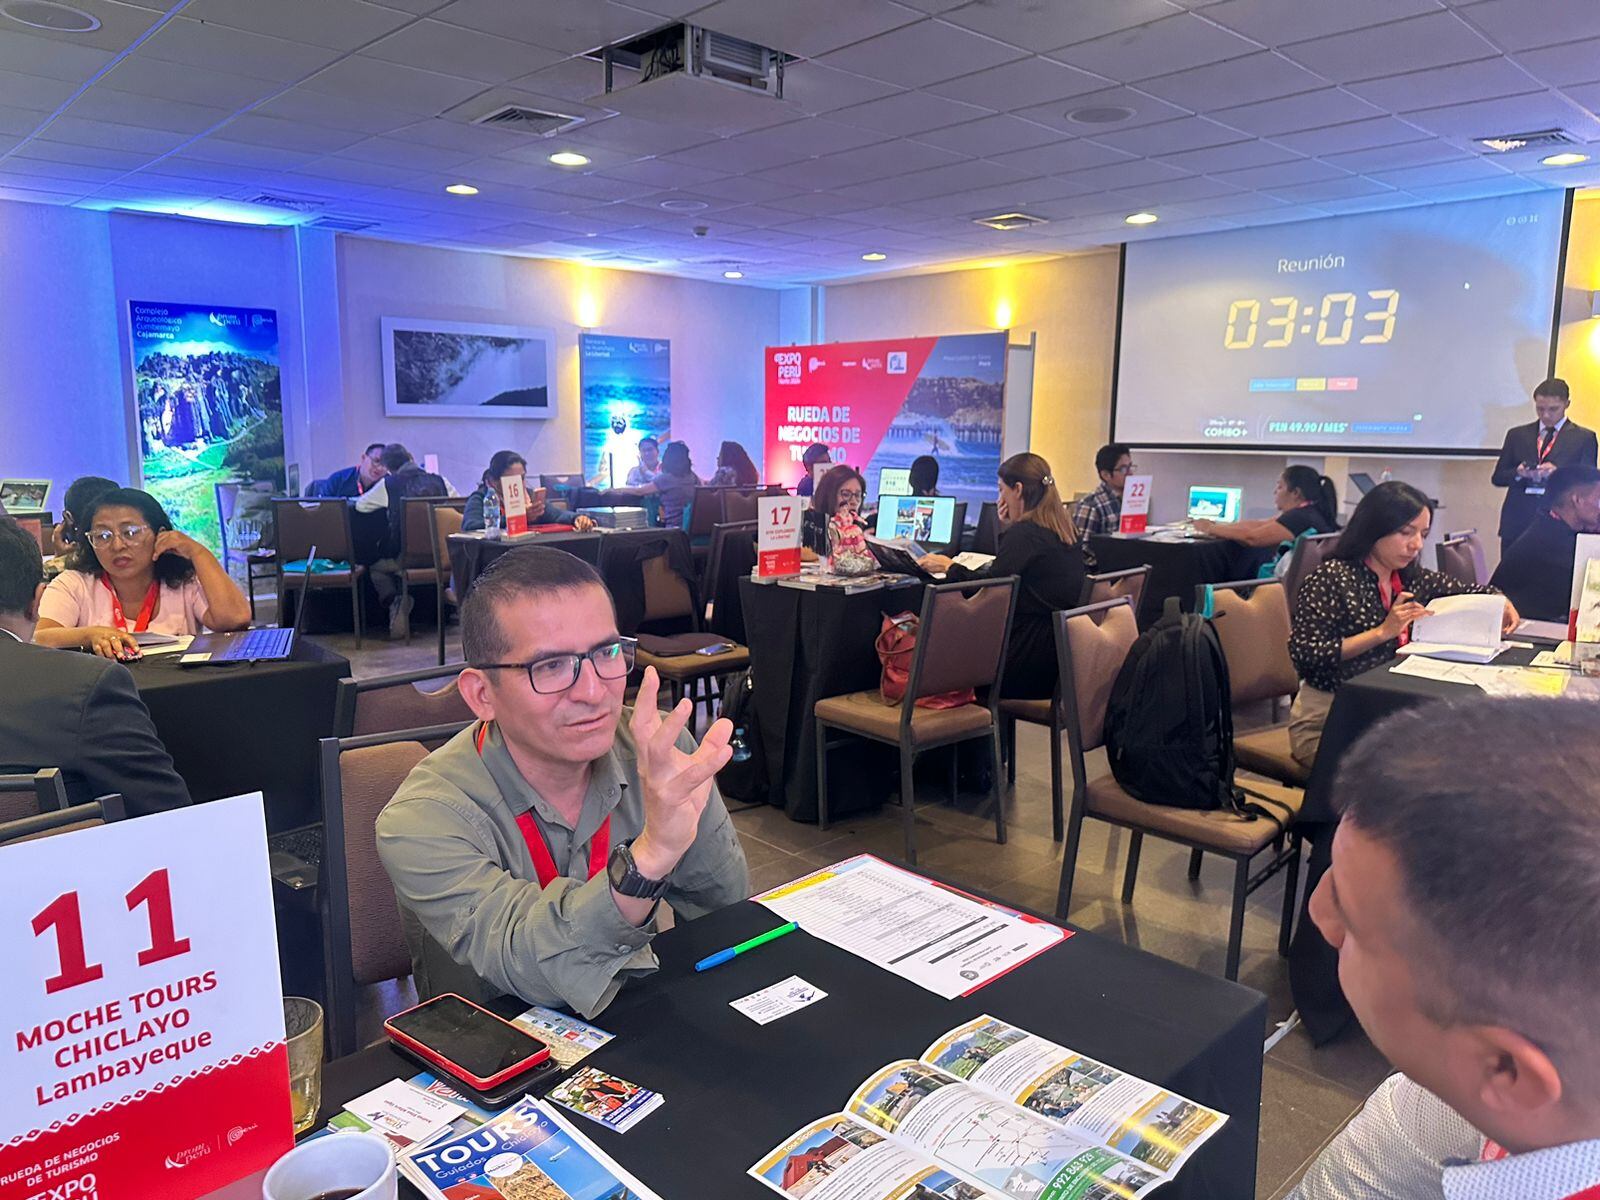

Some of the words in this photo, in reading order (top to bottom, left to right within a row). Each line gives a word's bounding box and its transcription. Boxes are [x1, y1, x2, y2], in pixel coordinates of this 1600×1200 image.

[1277, 254, 1345, 273] Reunión
[135, 307, 168, 316] Complejo
[1224, 289, 1400, 349] 03:03
[137, 331, 175, 340] Cajamarca
[787, 406, 830, 423] RUEDA
[832, 406, 851, 423] DE
[778, 425, 840, 443] NEGOCIOS
[842, 426, 861, 443] DE
[789, 445, 847, 463] TUMO
[508, 483, 519, 498] 16
[1130, 483, 1145, 497] 22
[771, 507, 791, 525] 17
[31, 867, 191, 994] 11
[16, 1000, 122, 1052] MOCHE
[129, 970, 217, 1014] TOURS
[55, 1008, 190, 1068] CHICLAYO
[36, 1031, 212, 1106] Lambayeque
[415, 1104, 539, 1172] TOURS
[435, 1156, 488, 1179] Guiados
[501, 1120, 549, 1151] Chiclayo
[0, 1163, 42, 1186] RUEDA
[44, 1155, 60, 1169] DE
[63, 1132, 120, 1160] NEGOCIOS
[26, 1174, 43, 1187] DE
[45, 1152, 98, 1179] TURISMO
